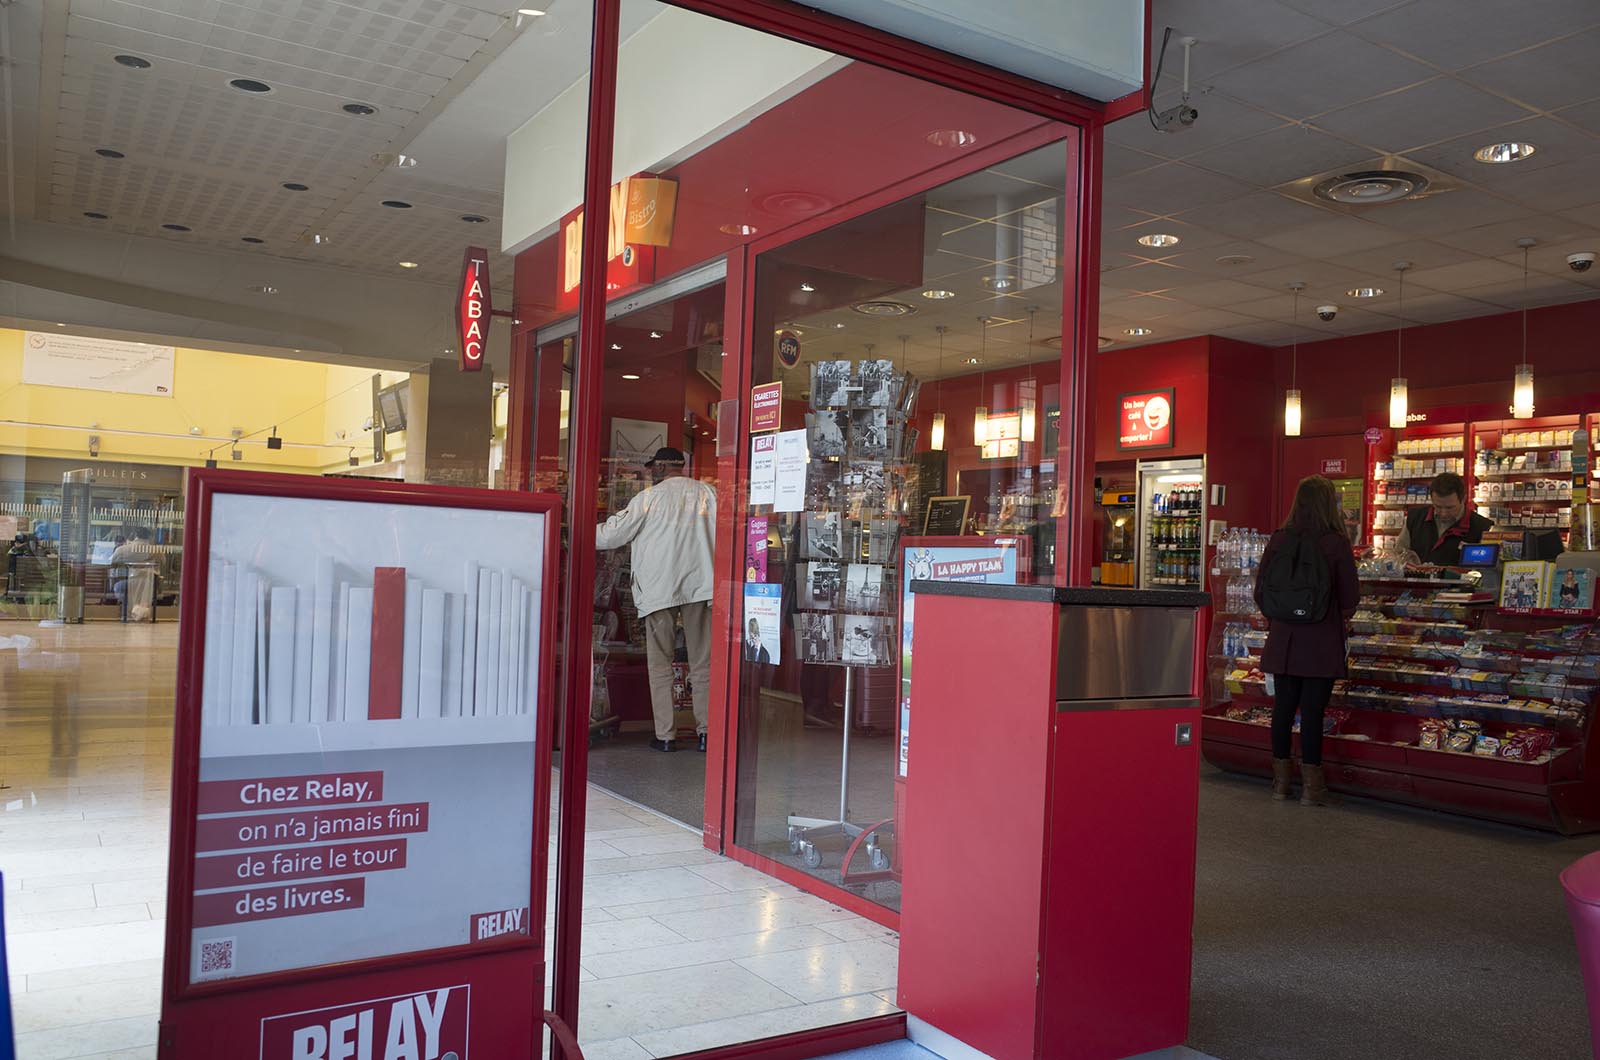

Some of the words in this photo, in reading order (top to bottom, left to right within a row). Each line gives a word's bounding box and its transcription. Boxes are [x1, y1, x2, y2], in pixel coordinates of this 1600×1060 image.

[629, 200, 656, 225] Bistro
[465, 258, 485, 360] TABAC
[781, 342, 797, 357] RFM
[1405, 413, 1427, 422] abac
[937, 564, 949, 576] LA
[950, 562, 977, 574] HAPPY
[979, 559, 1002, 572] TEAM
[240, 783, 299, 804] Chez
[305, 777, 374, 802] Relay,
[238, 826, 267, 841] on
[309, 812, 382, 842] jamais
[387, 808, 420, 828] fini
[237, 857, 265, 879] de
[271, 853, 323, 875] faire
[329, 848, 347, 869] le
[352, 848, 398, 866] tour
[235, 893, 278, 915] des
[283, 886, 352, 910] livres.
[478, 907, 523, 940] RELAY
